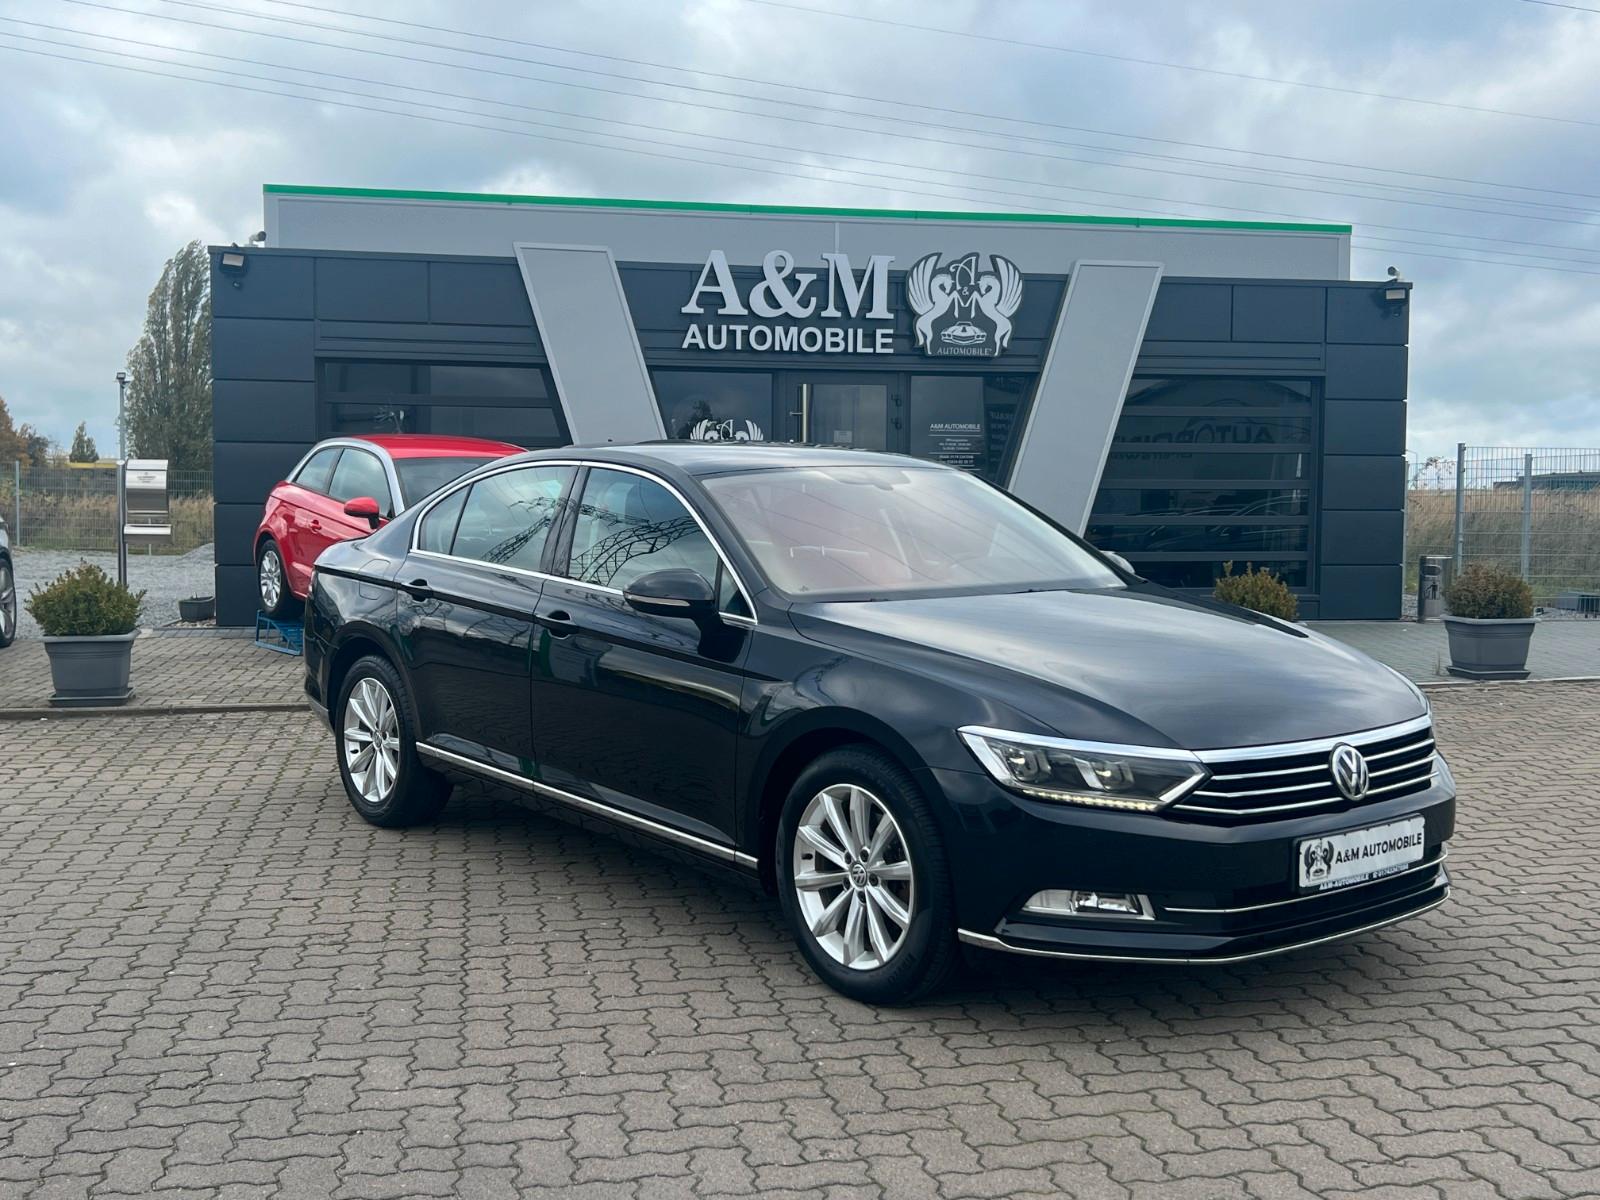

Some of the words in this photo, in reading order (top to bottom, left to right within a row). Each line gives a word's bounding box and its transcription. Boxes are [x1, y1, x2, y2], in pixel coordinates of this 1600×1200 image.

[681, 250, 895, 319] A&M
[681, 323, 894, 353] AUTOMOBILE
[937, 347, 989, 356] AUTOMOBILE
[1335, 846, 1360, 864] A&M
[1362, 833, 1422, 859] AUTOMOBILE
